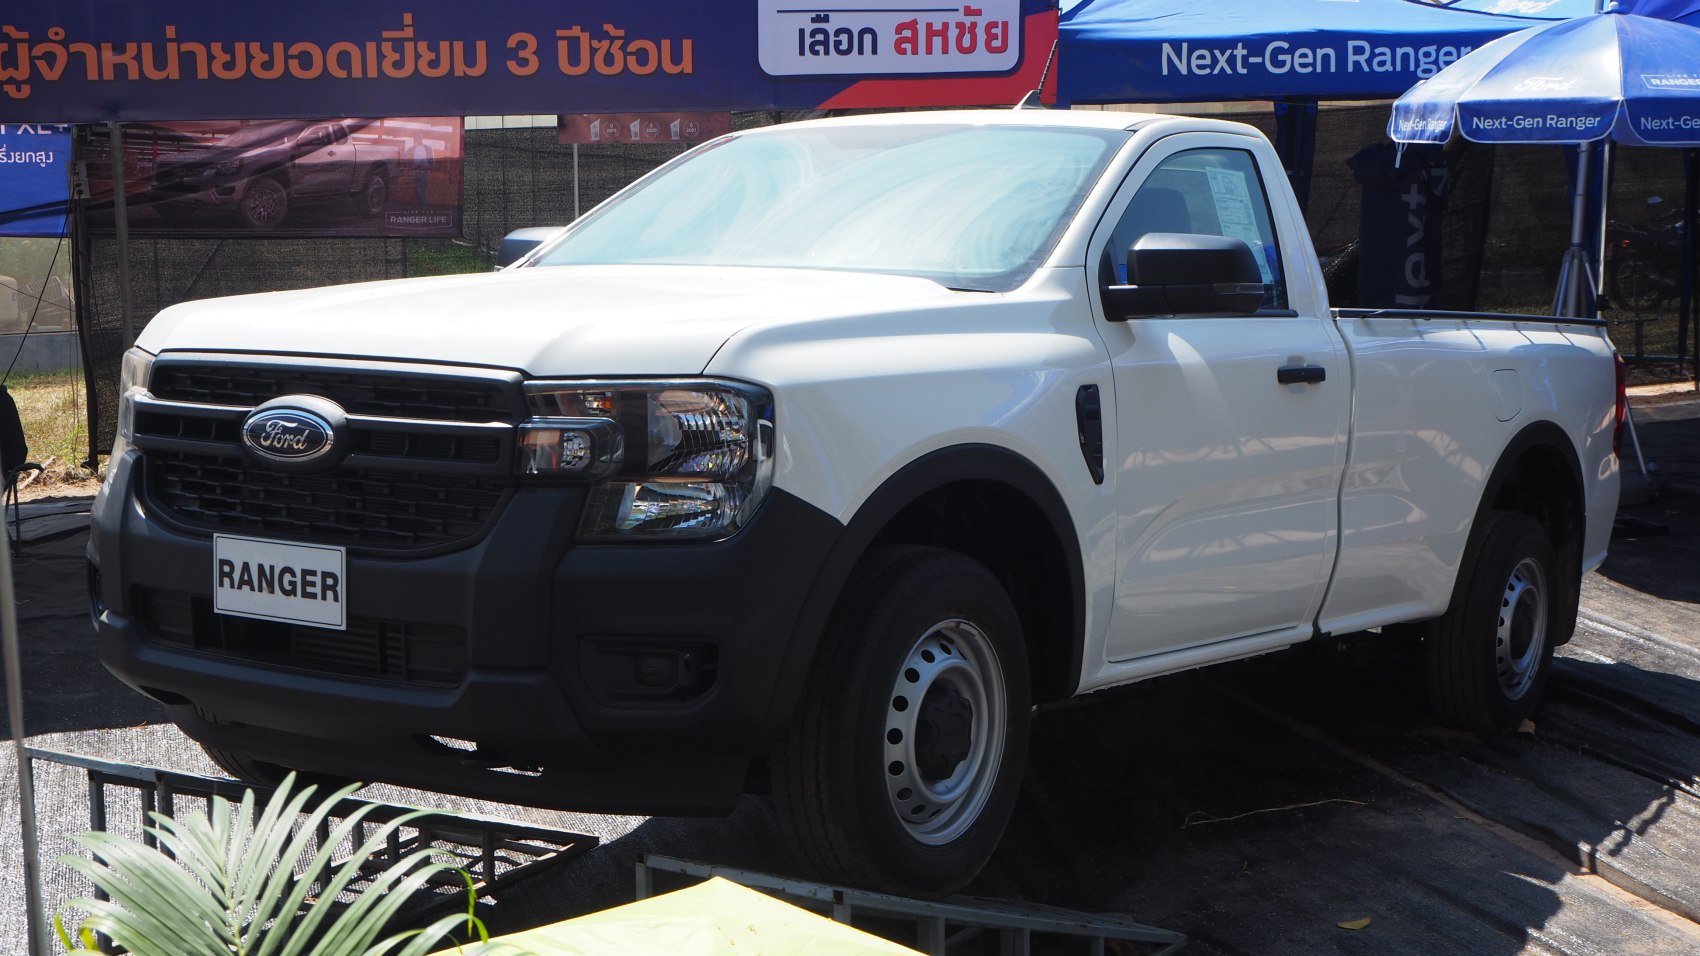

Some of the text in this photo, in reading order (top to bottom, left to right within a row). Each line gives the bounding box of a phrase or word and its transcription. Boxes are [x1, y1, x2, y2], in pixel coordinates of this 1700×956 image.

[798, 5, 1009, 57] เลือก สหชัย
[0, 12, 693, 99] ผู้จำหน่ายยอดเยี่ยม 3 ปีซ้อน
[1161, 40, 1336, 76] Next-Gen
[1513, 76, 1576, 91] Ford
[1398, 118, 1426, 131] Next-Gen
[1472, 115, 1601, 130] Next-Gen Ranger
[261, 419, 309, 451] Ford
[218, 558, 340, 603] RANGER
